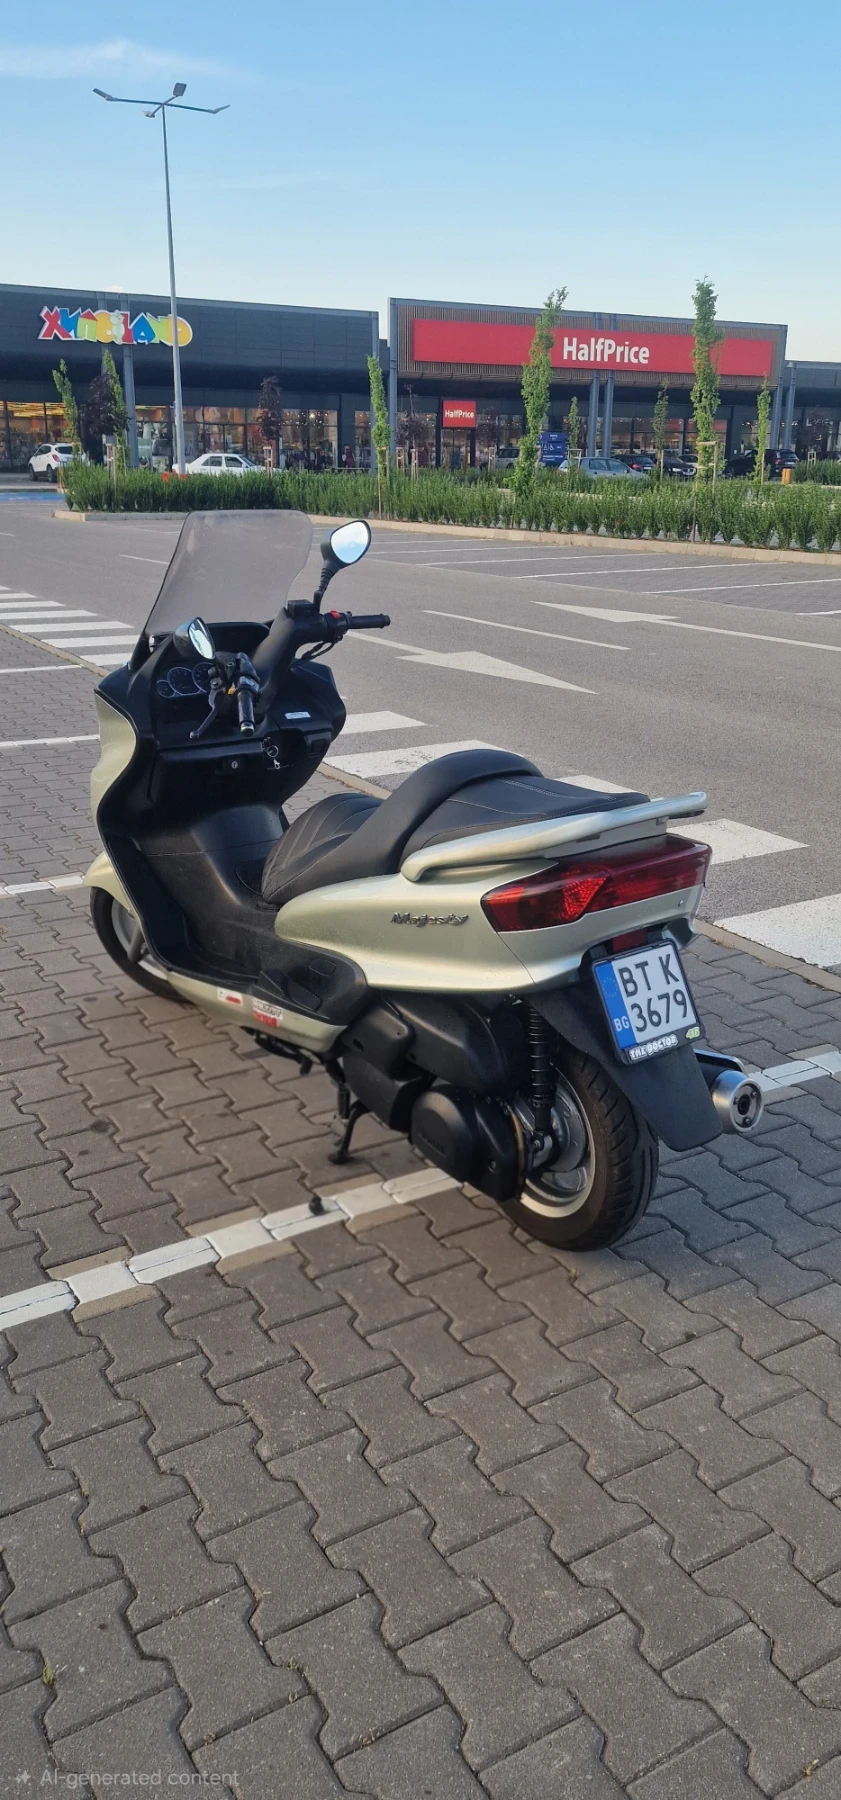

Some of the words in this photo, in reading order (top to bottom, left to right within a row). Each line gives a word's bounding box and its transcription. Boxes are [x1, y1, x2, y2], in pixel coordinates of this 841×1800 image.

[563, 336, 650, 364] HalfPrice
[444, 408, 475, 419] HalfPrice
[390, 912, 469, 928] Majesty
[618, 961, 653, 998] BT
[659, 953, 680, 985] K
[630, 988, 688, 1032] 3679
[613, 1016, 630, 1032] BG
[629, 1046, 647, 1060] THE
[646, 1034, 678, 1055] DOCTOR
